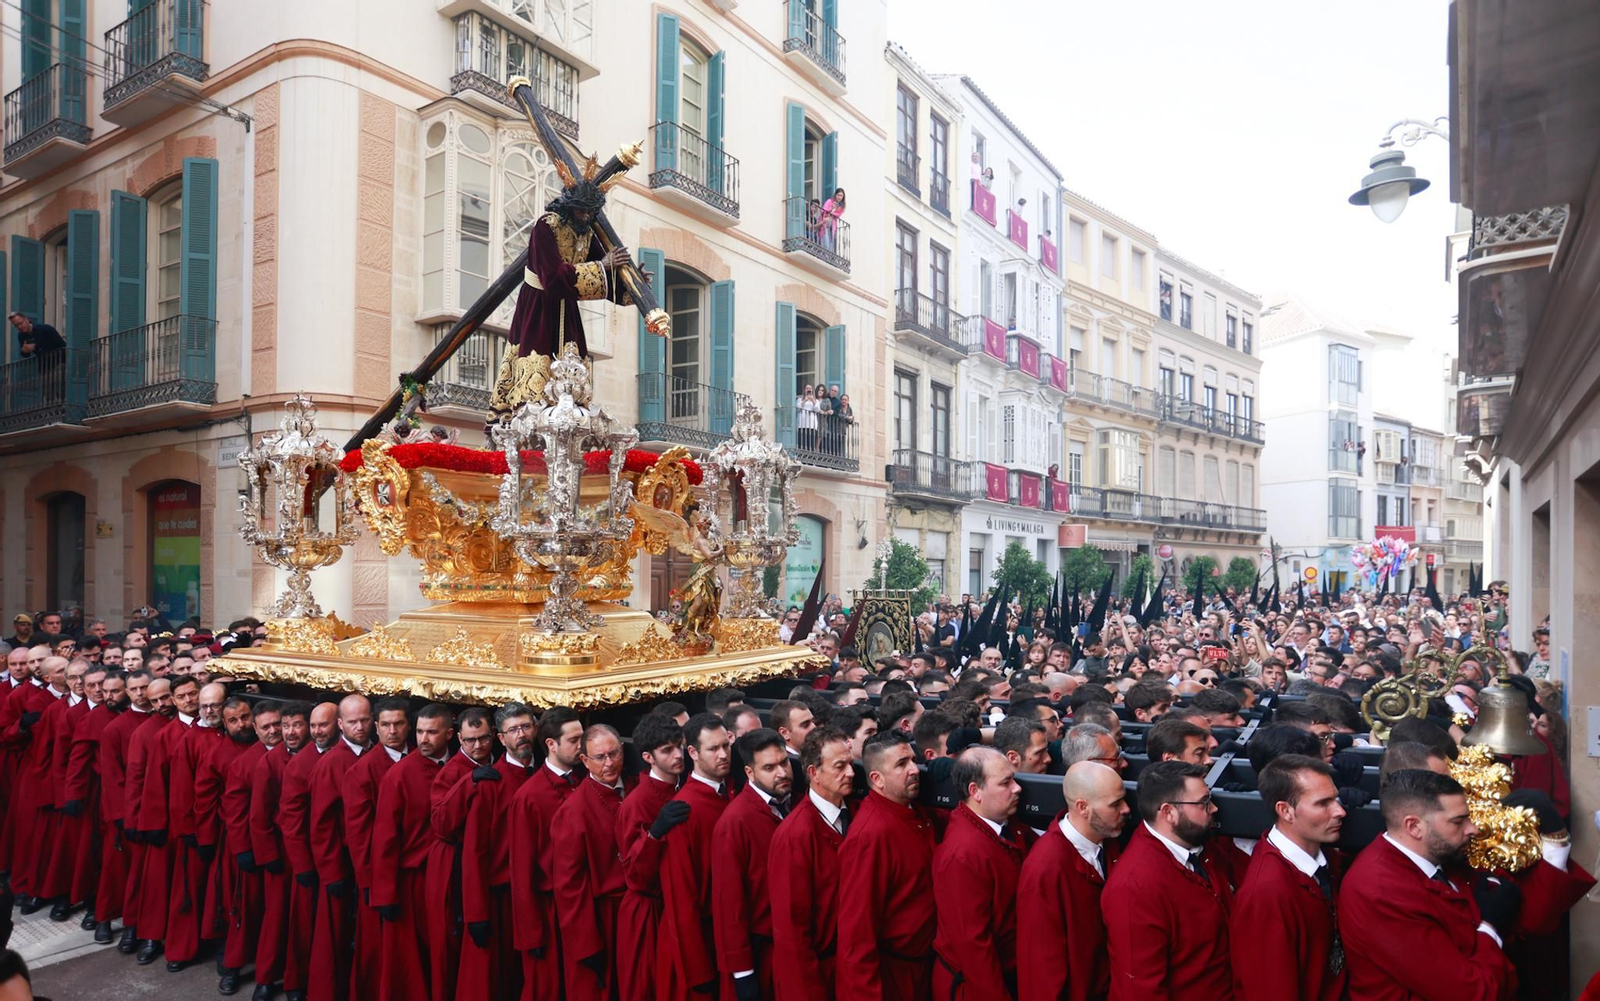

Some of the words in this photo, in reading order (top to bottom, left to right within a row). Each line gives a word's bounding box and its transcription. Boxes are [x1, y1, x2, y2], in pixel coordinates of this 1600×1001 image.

[222, 451, 240, 461] BIEDMA
[166, 489, 187, 501] natural
[158, 521, 170, 532] que
[1209, 649, 1227, 657] VLTN
